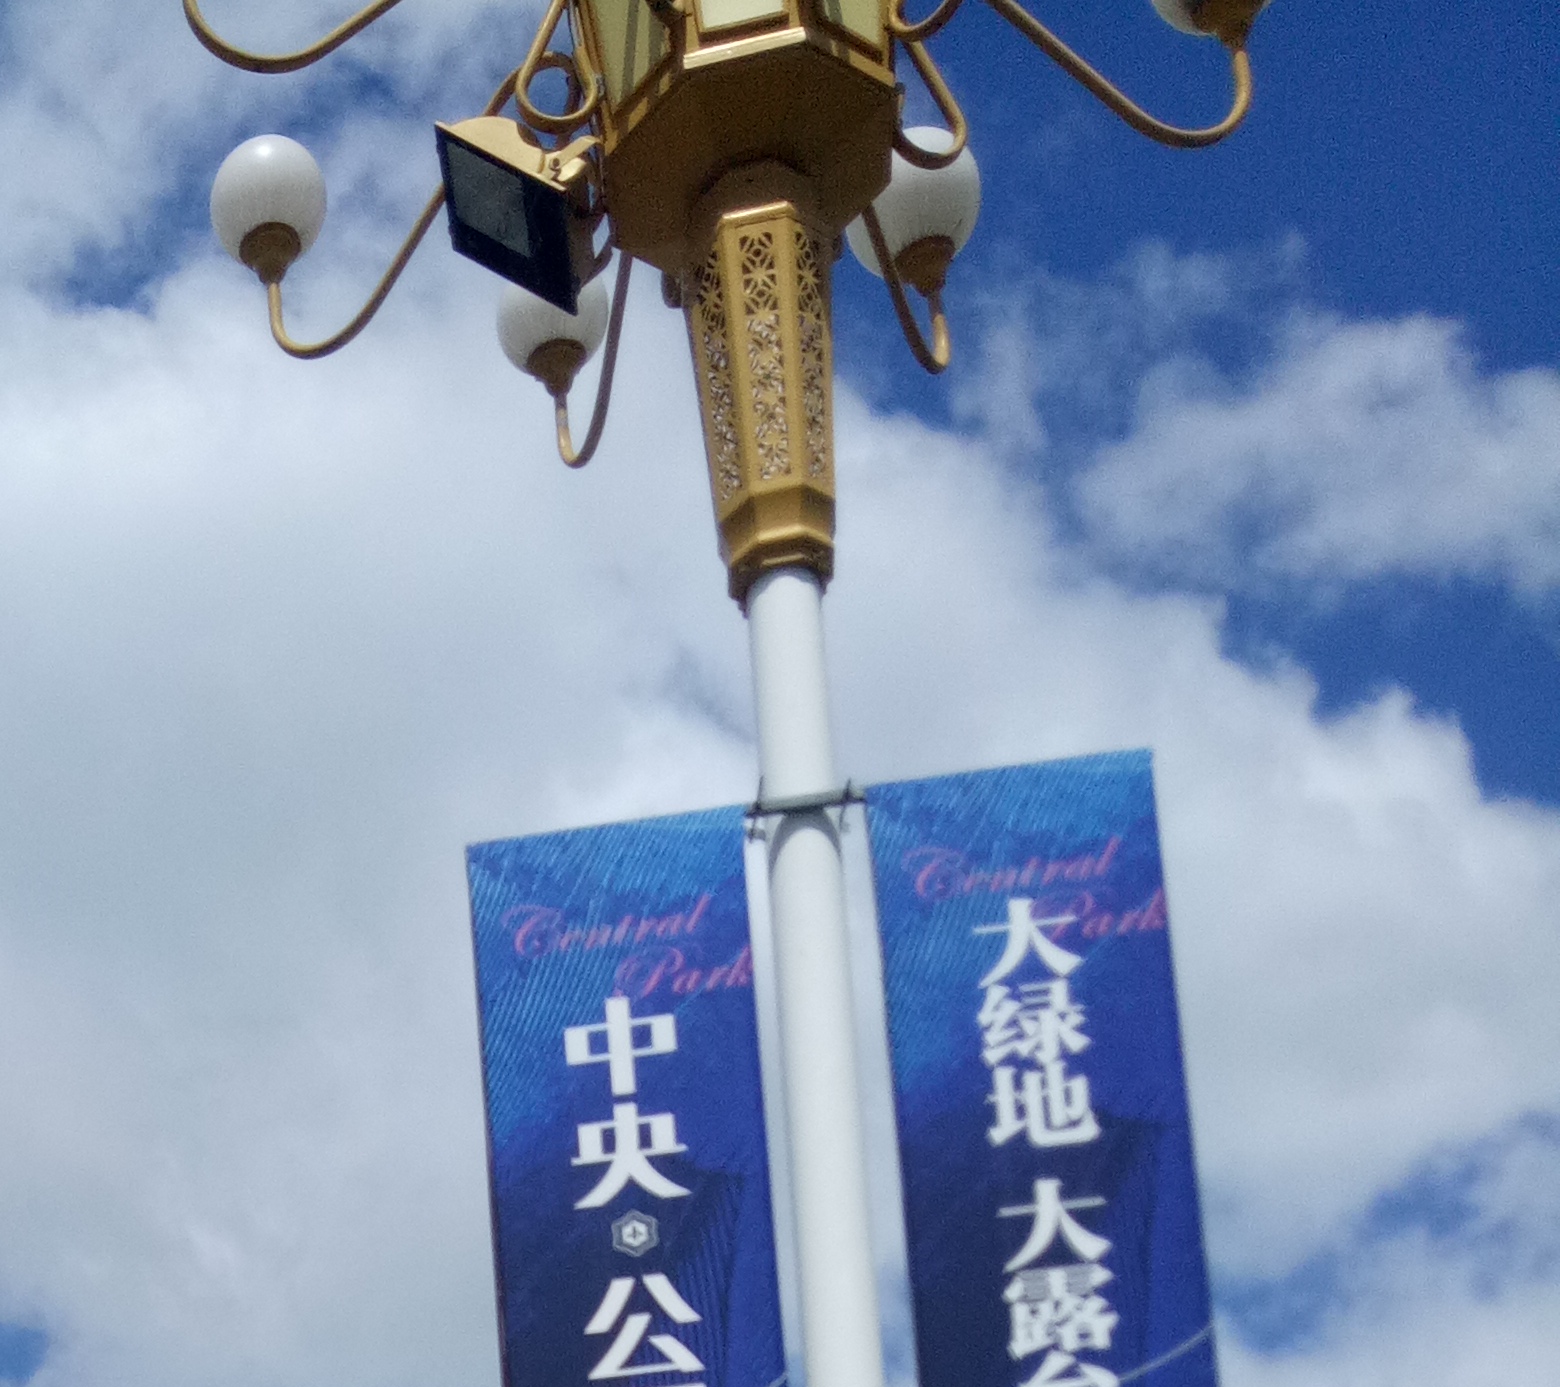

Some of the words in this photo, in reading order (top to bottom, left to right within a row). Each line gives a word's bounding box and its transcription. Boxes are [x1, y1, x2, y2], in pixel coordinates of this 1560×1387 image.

[901, 835, 1122, 898] Central
[501, 893, 712, 958] Central
[972, 898, 1102, 1148] 大绿地
